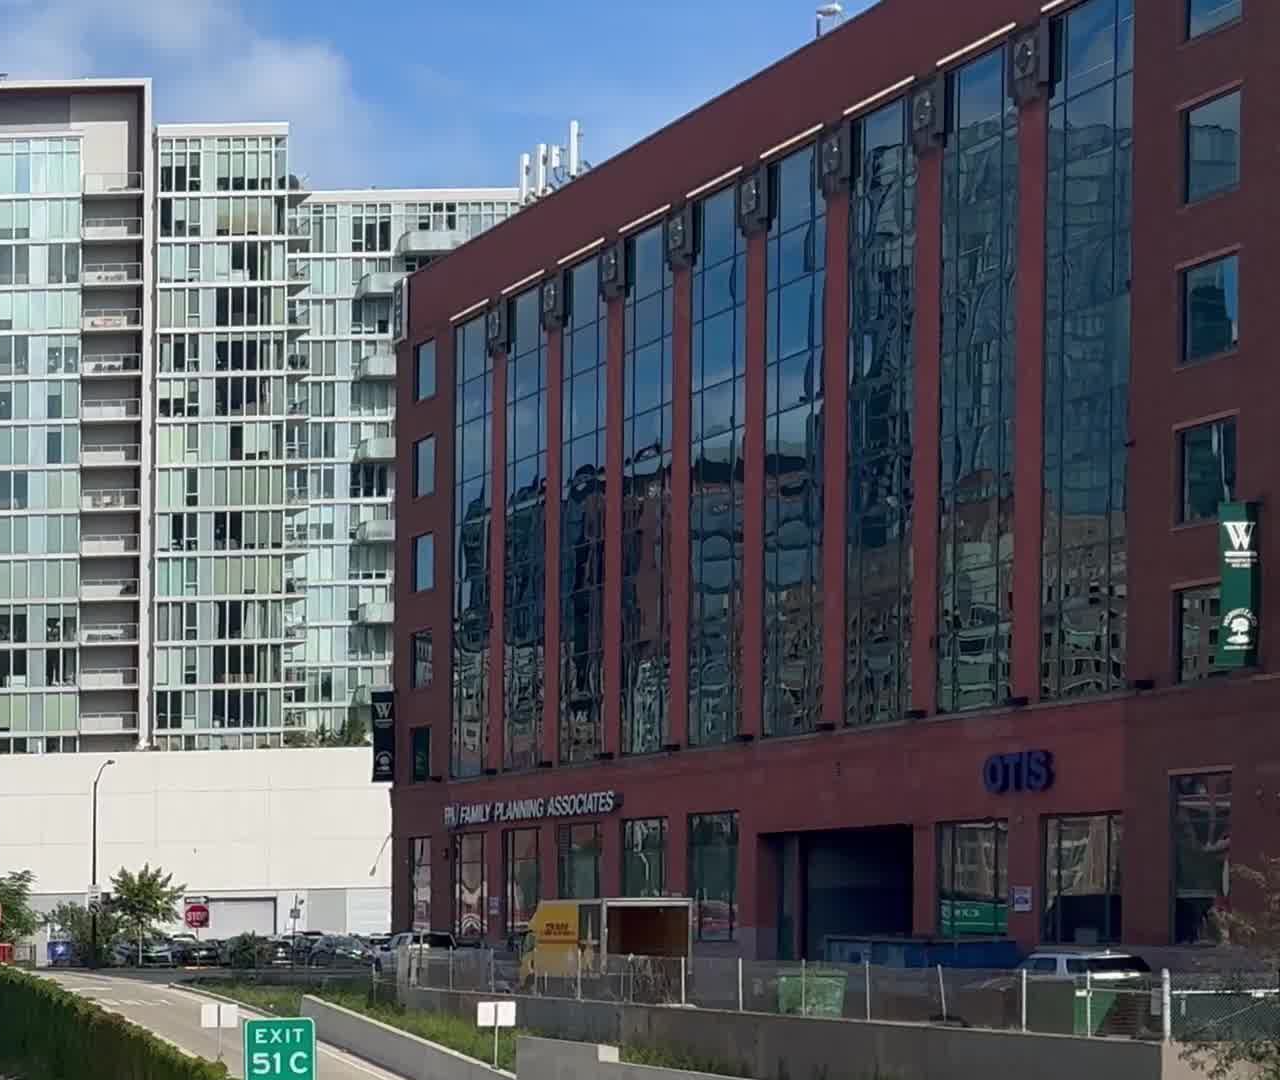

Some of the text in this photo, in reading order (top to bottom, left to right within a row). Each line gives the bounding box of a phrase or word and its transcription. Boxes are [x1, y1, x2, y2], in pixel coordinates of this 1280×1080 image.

[983, 750, 1051, 792] OTIS
[460, 803, 491, 825] FAMILY
[494, 798, 544, 822] PLANNING
[547, 790, 615, 817] ASSOCIATES
[255, 1027, 305, 1044] EXIT
